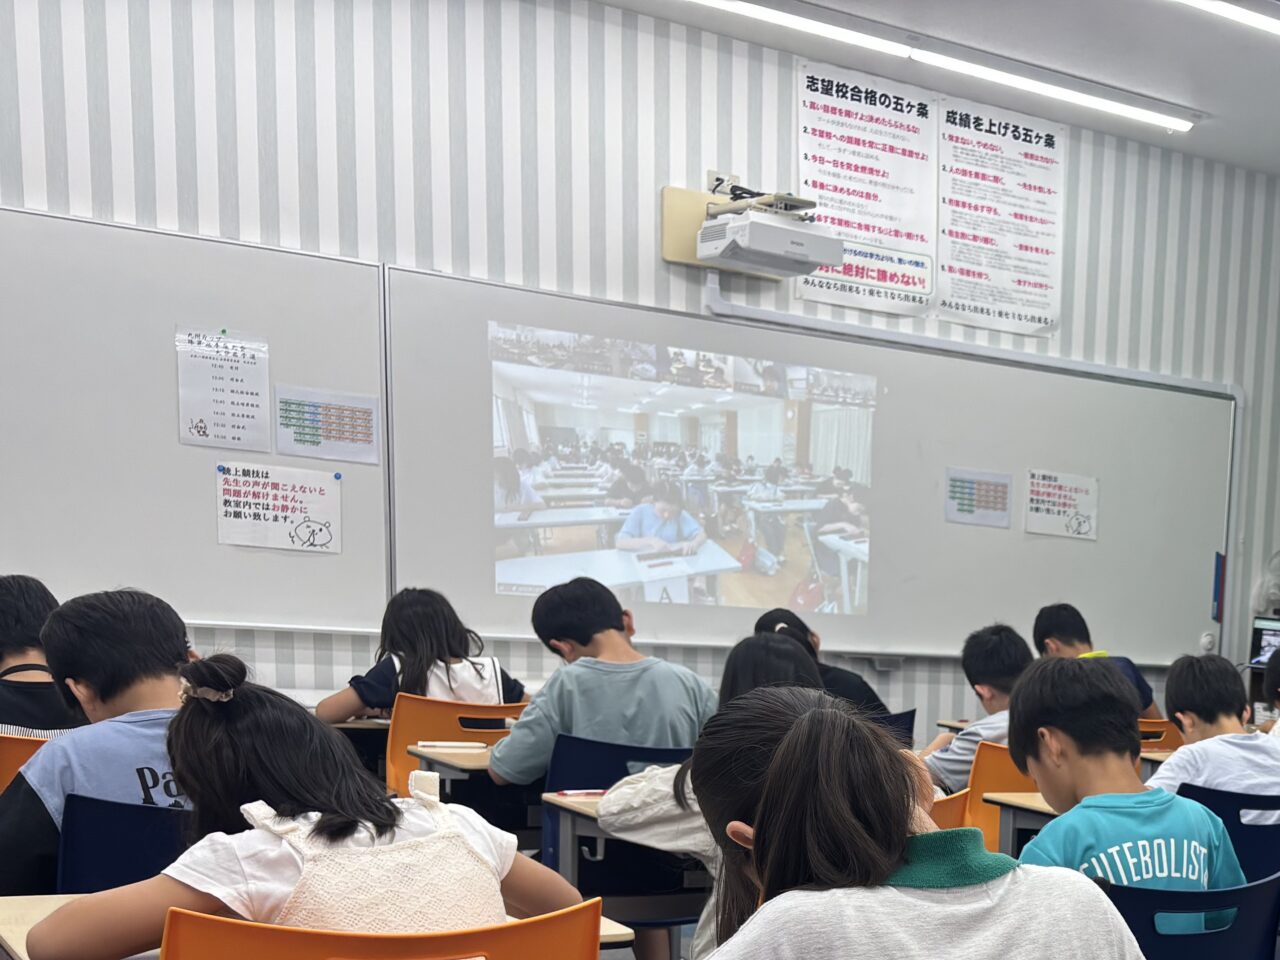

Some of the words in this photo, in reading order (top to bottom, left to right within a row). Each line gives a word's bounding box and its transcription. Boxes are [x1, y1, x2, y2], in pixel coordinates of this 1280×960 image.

[222, 477, 326, 496] 先生の声が聞こえないと
[222, 488, 303, 504] 問題が解けません。
[224, 510, 294, 524] お願い致します。
